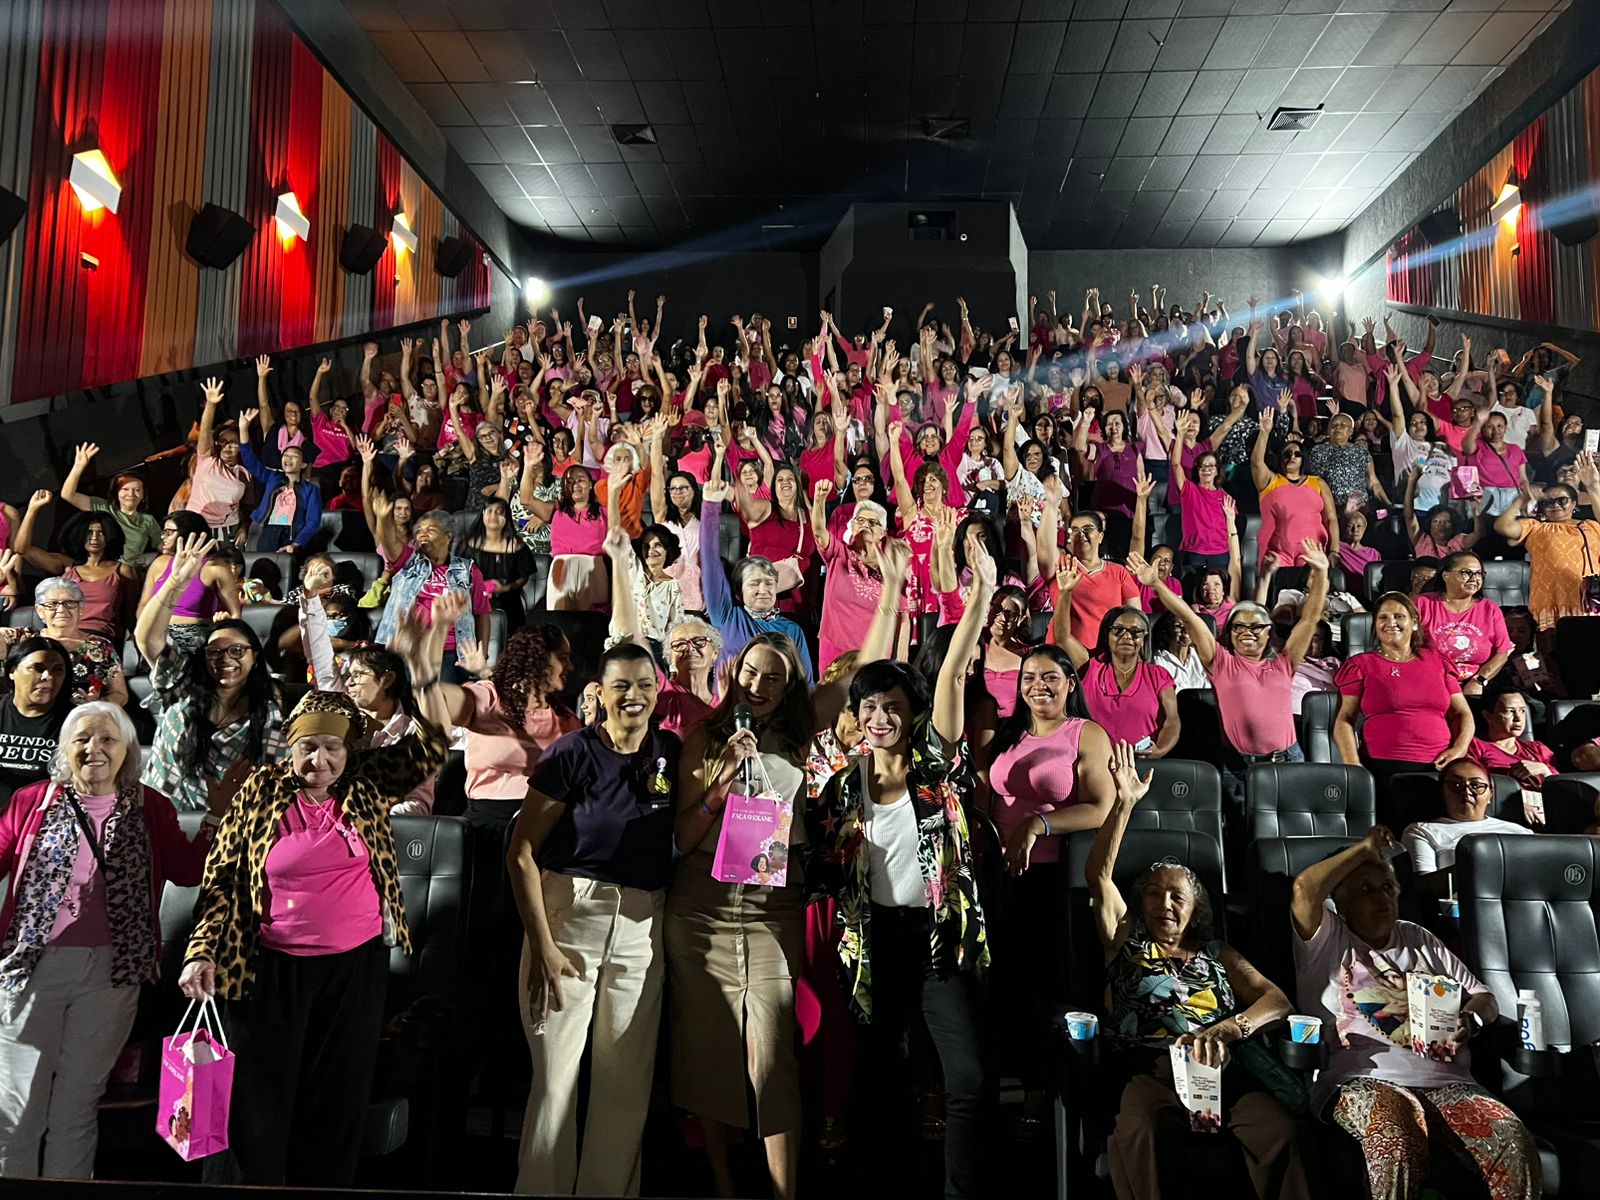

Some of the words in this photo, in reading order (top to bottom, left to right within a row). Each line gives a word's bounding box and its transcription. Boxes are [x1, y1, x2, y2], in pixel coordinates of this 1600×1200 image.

[0, 744, 52, 762] EUS
[1174, 783, 1186, 796] 07
[1327, 787, 1339, 799] 06
[410, 842, 423, 857] 10
[1567, 866, 1582, 882] 05
